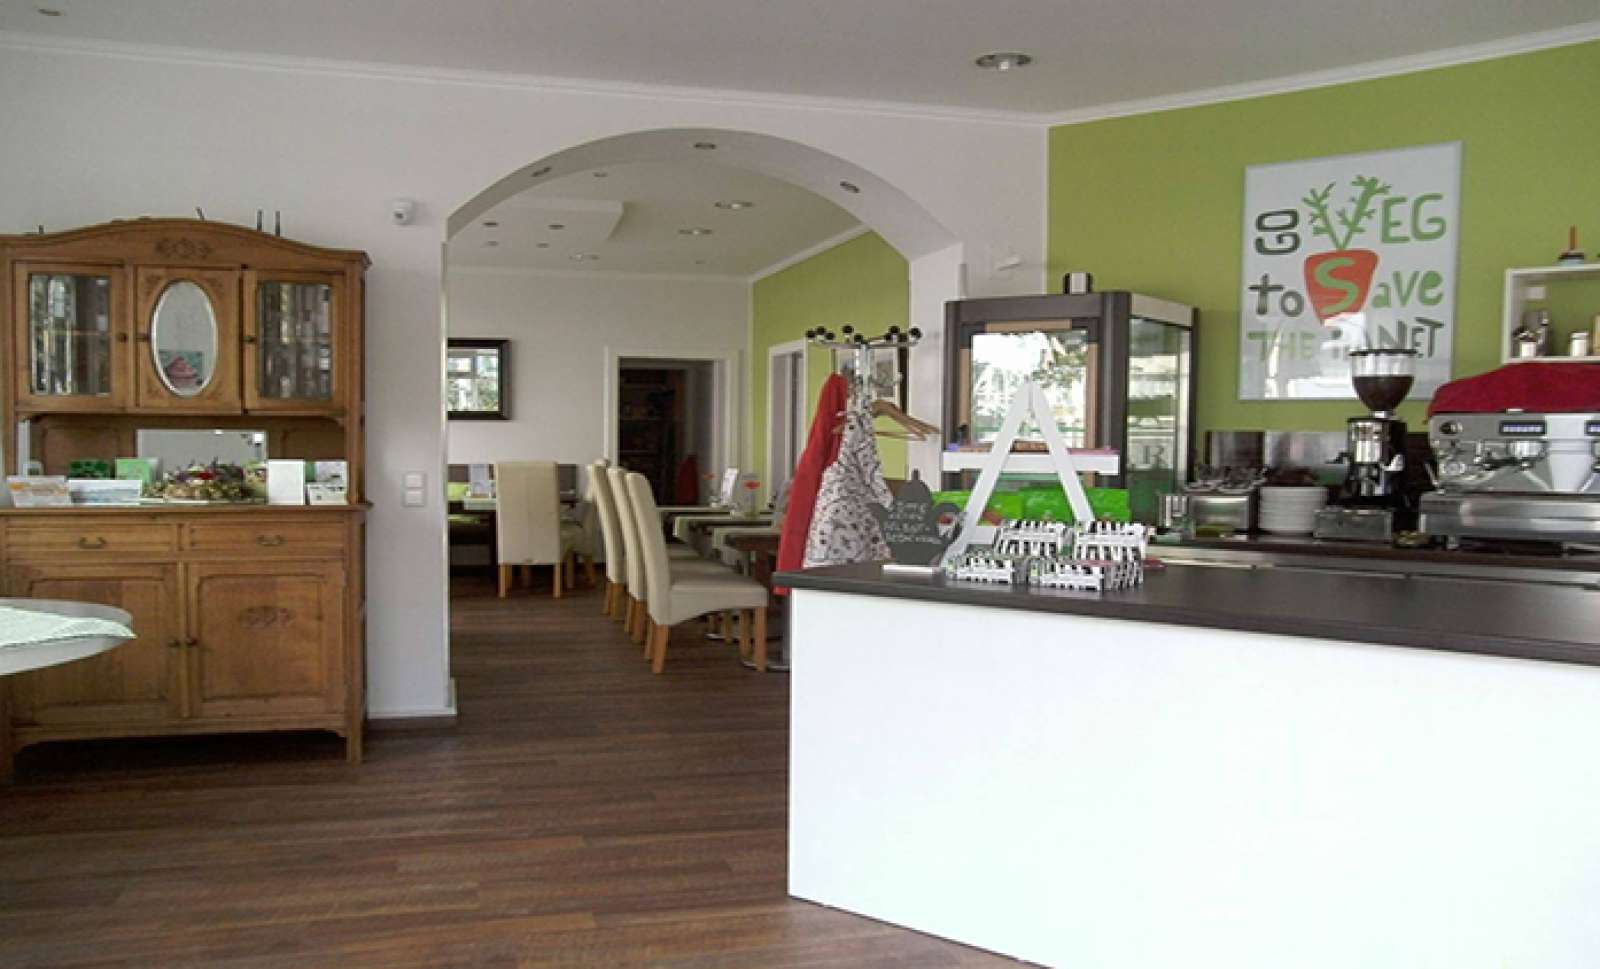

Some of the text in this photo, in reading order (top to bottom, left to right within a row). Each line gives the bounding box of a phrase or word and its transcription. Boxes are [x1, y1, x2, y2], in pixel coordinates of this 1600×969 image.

[1255, 208, 1300, 255] GO
[1249, 257, 1444, 317] to Save
[1248, 329, 1316, 362] THE
